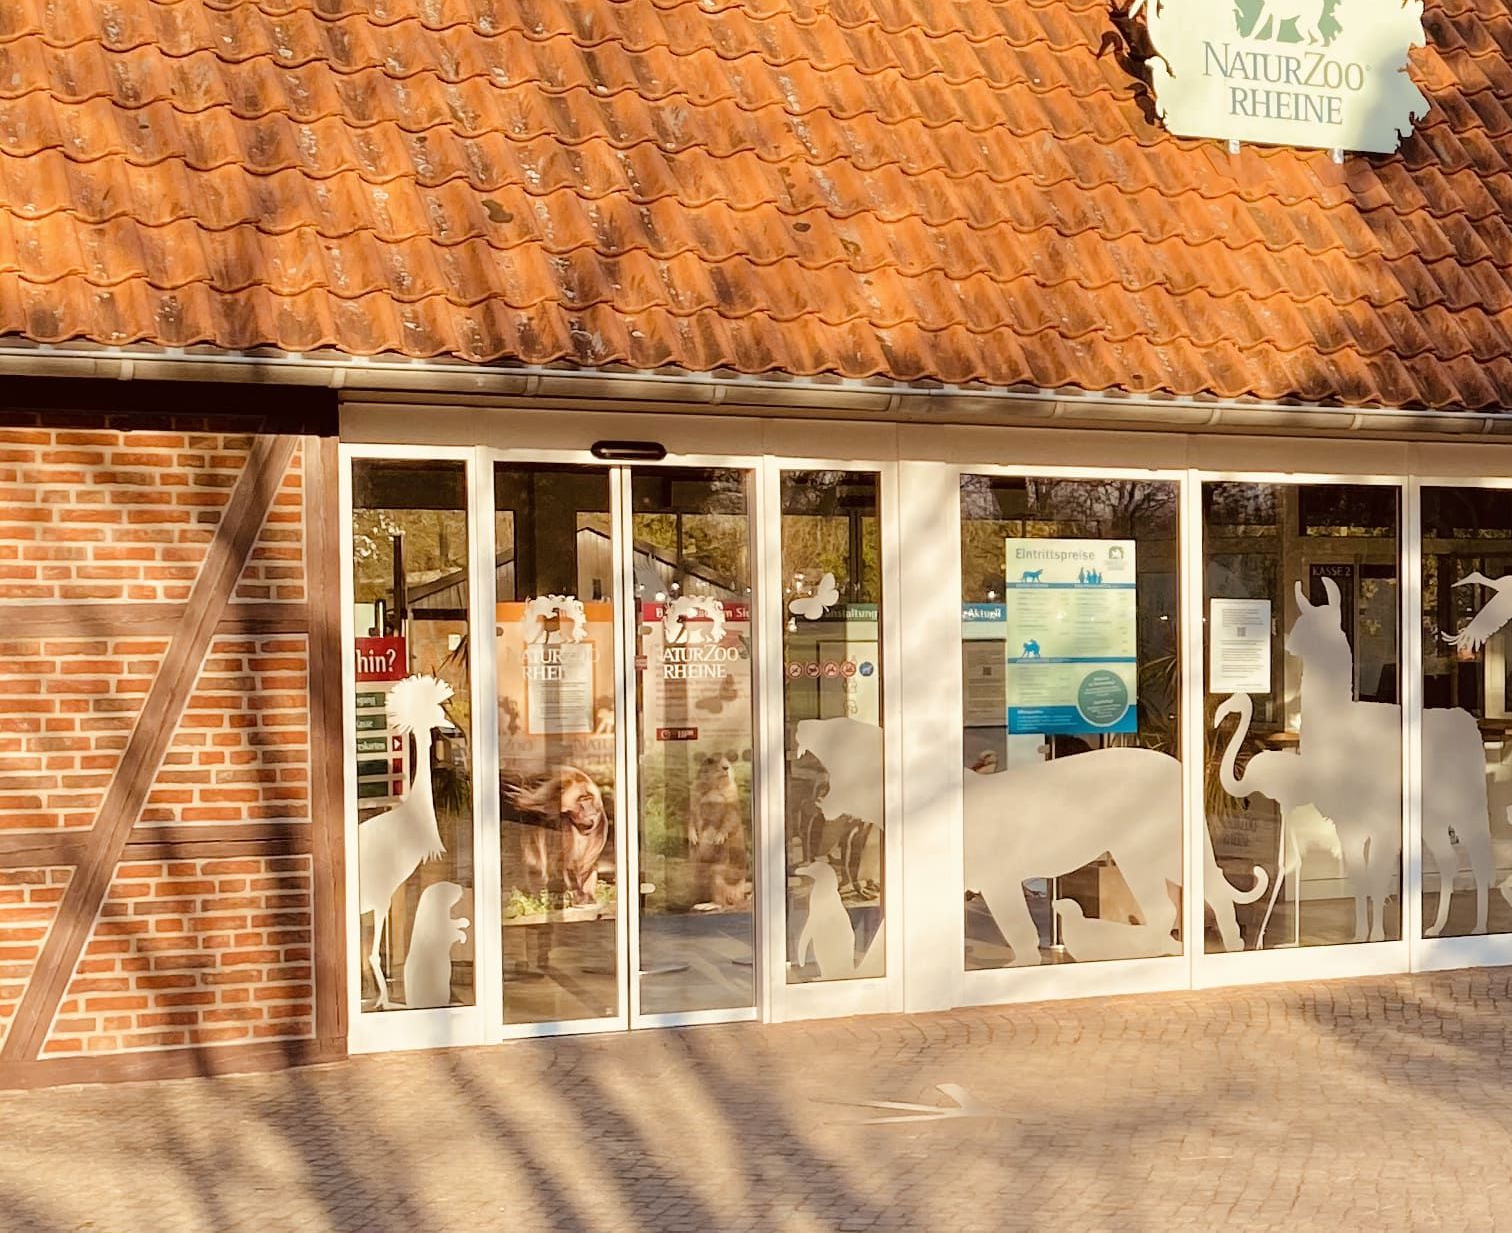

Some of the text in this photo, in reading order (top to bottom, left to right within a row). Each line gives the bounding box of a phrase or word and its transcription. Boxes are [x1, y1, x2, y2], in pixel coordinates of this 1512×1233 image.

[1229, 87, 1343, 125] RHEINE
[1015, 548, 1096, 561] Eintrittspreise
[1312, 566, 1352, 577] KASSE 2
[664, 663, 727, 679] RHEINE
